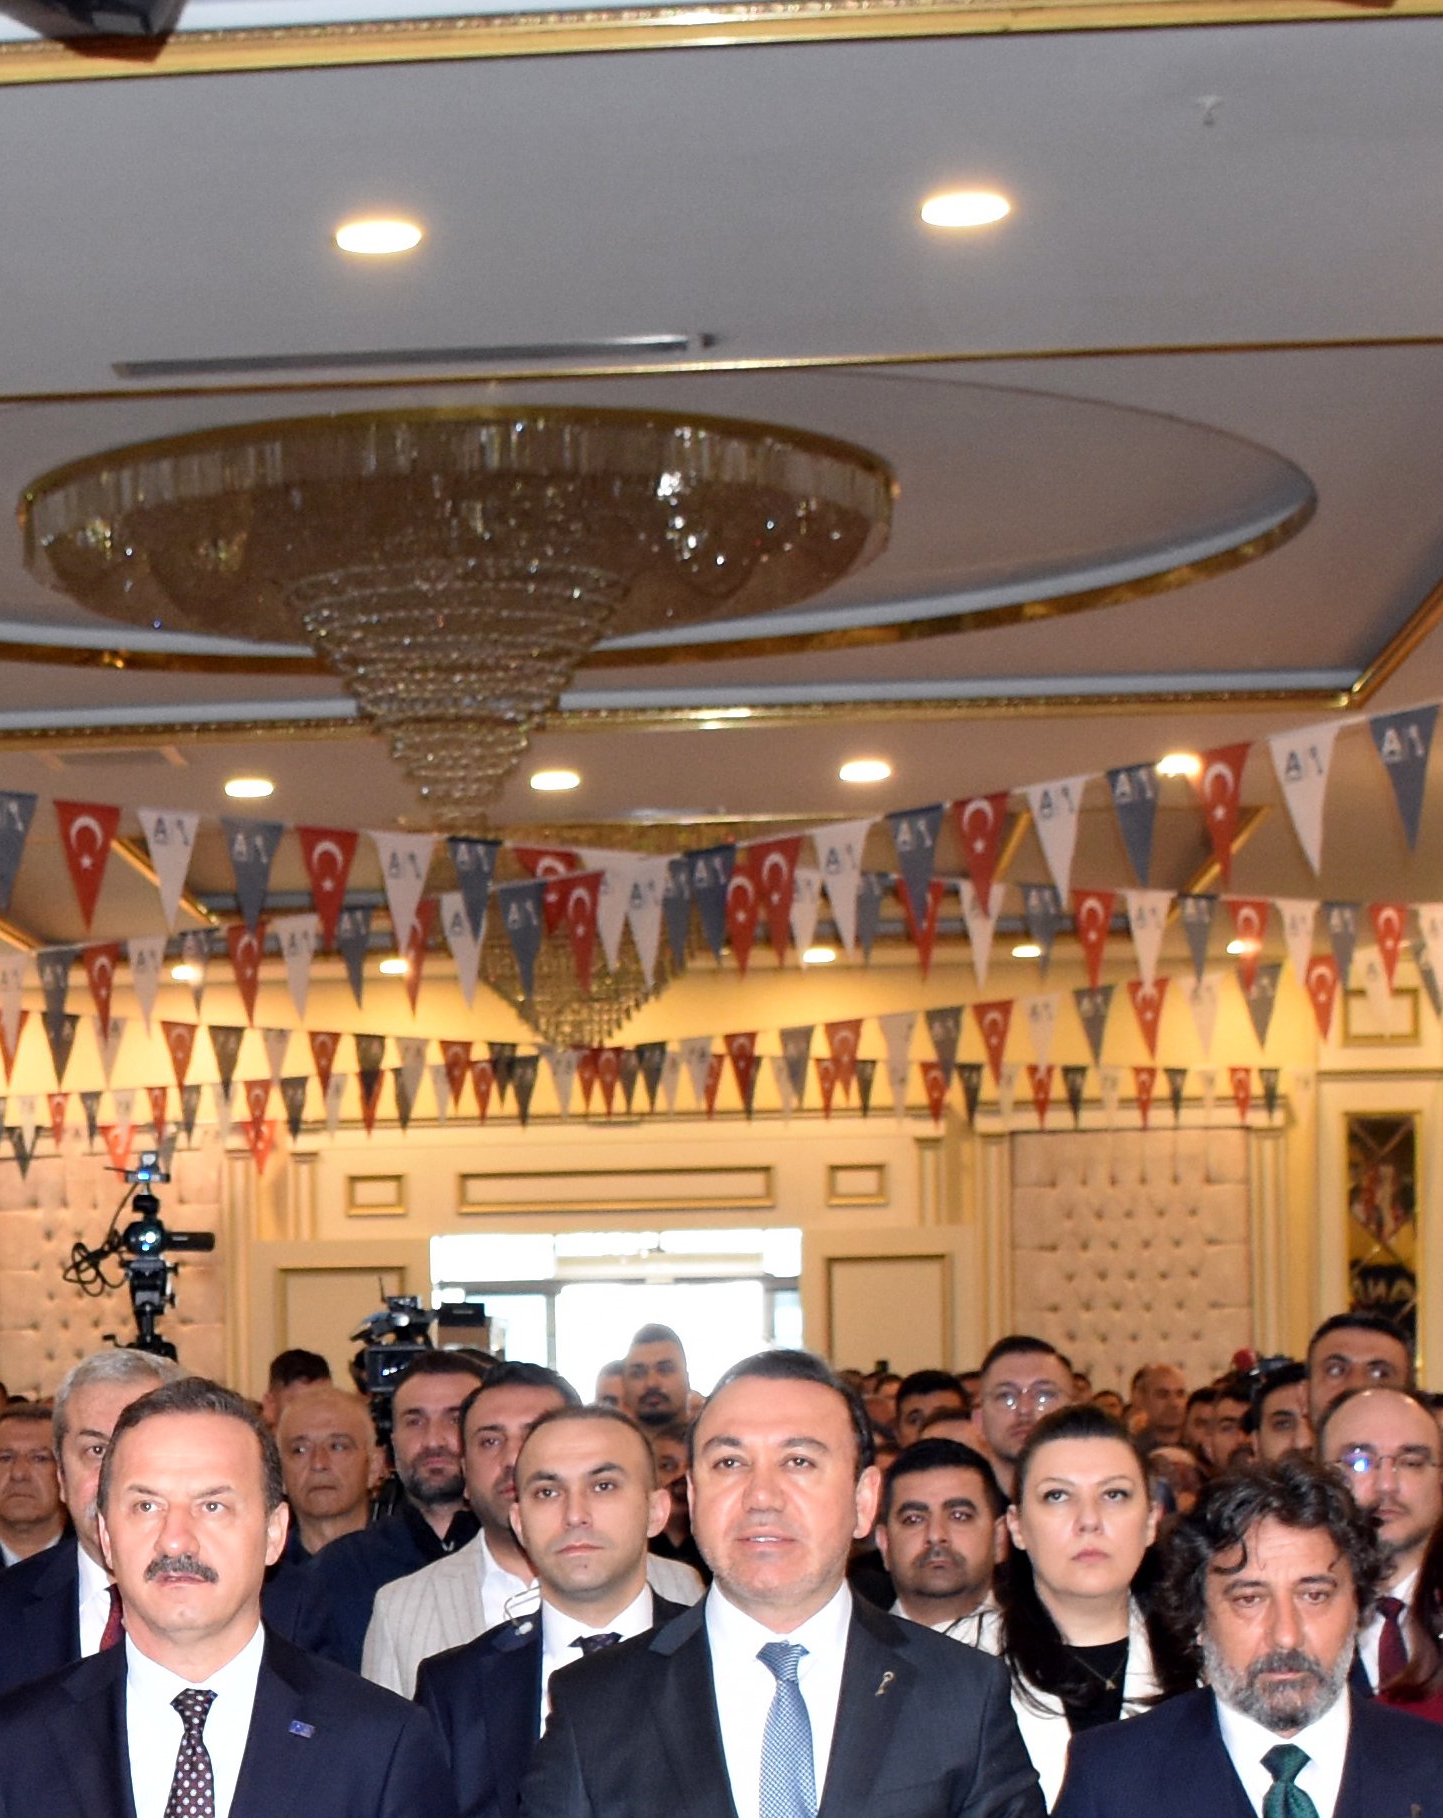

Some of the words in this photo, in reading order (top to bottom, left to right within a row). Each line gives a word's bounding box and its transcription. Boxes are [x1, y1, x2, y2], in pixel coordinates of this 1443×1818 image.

[1381, 730, 1400, 754] A
[1285, 752, 1301, 774] A
[1115, 774, 1130, 795] A
[898, 822, 911, 844] A
[233, 833, 246, 856] A
[457, 844, 470, 864] A
[694, 860, 707, 882] A
